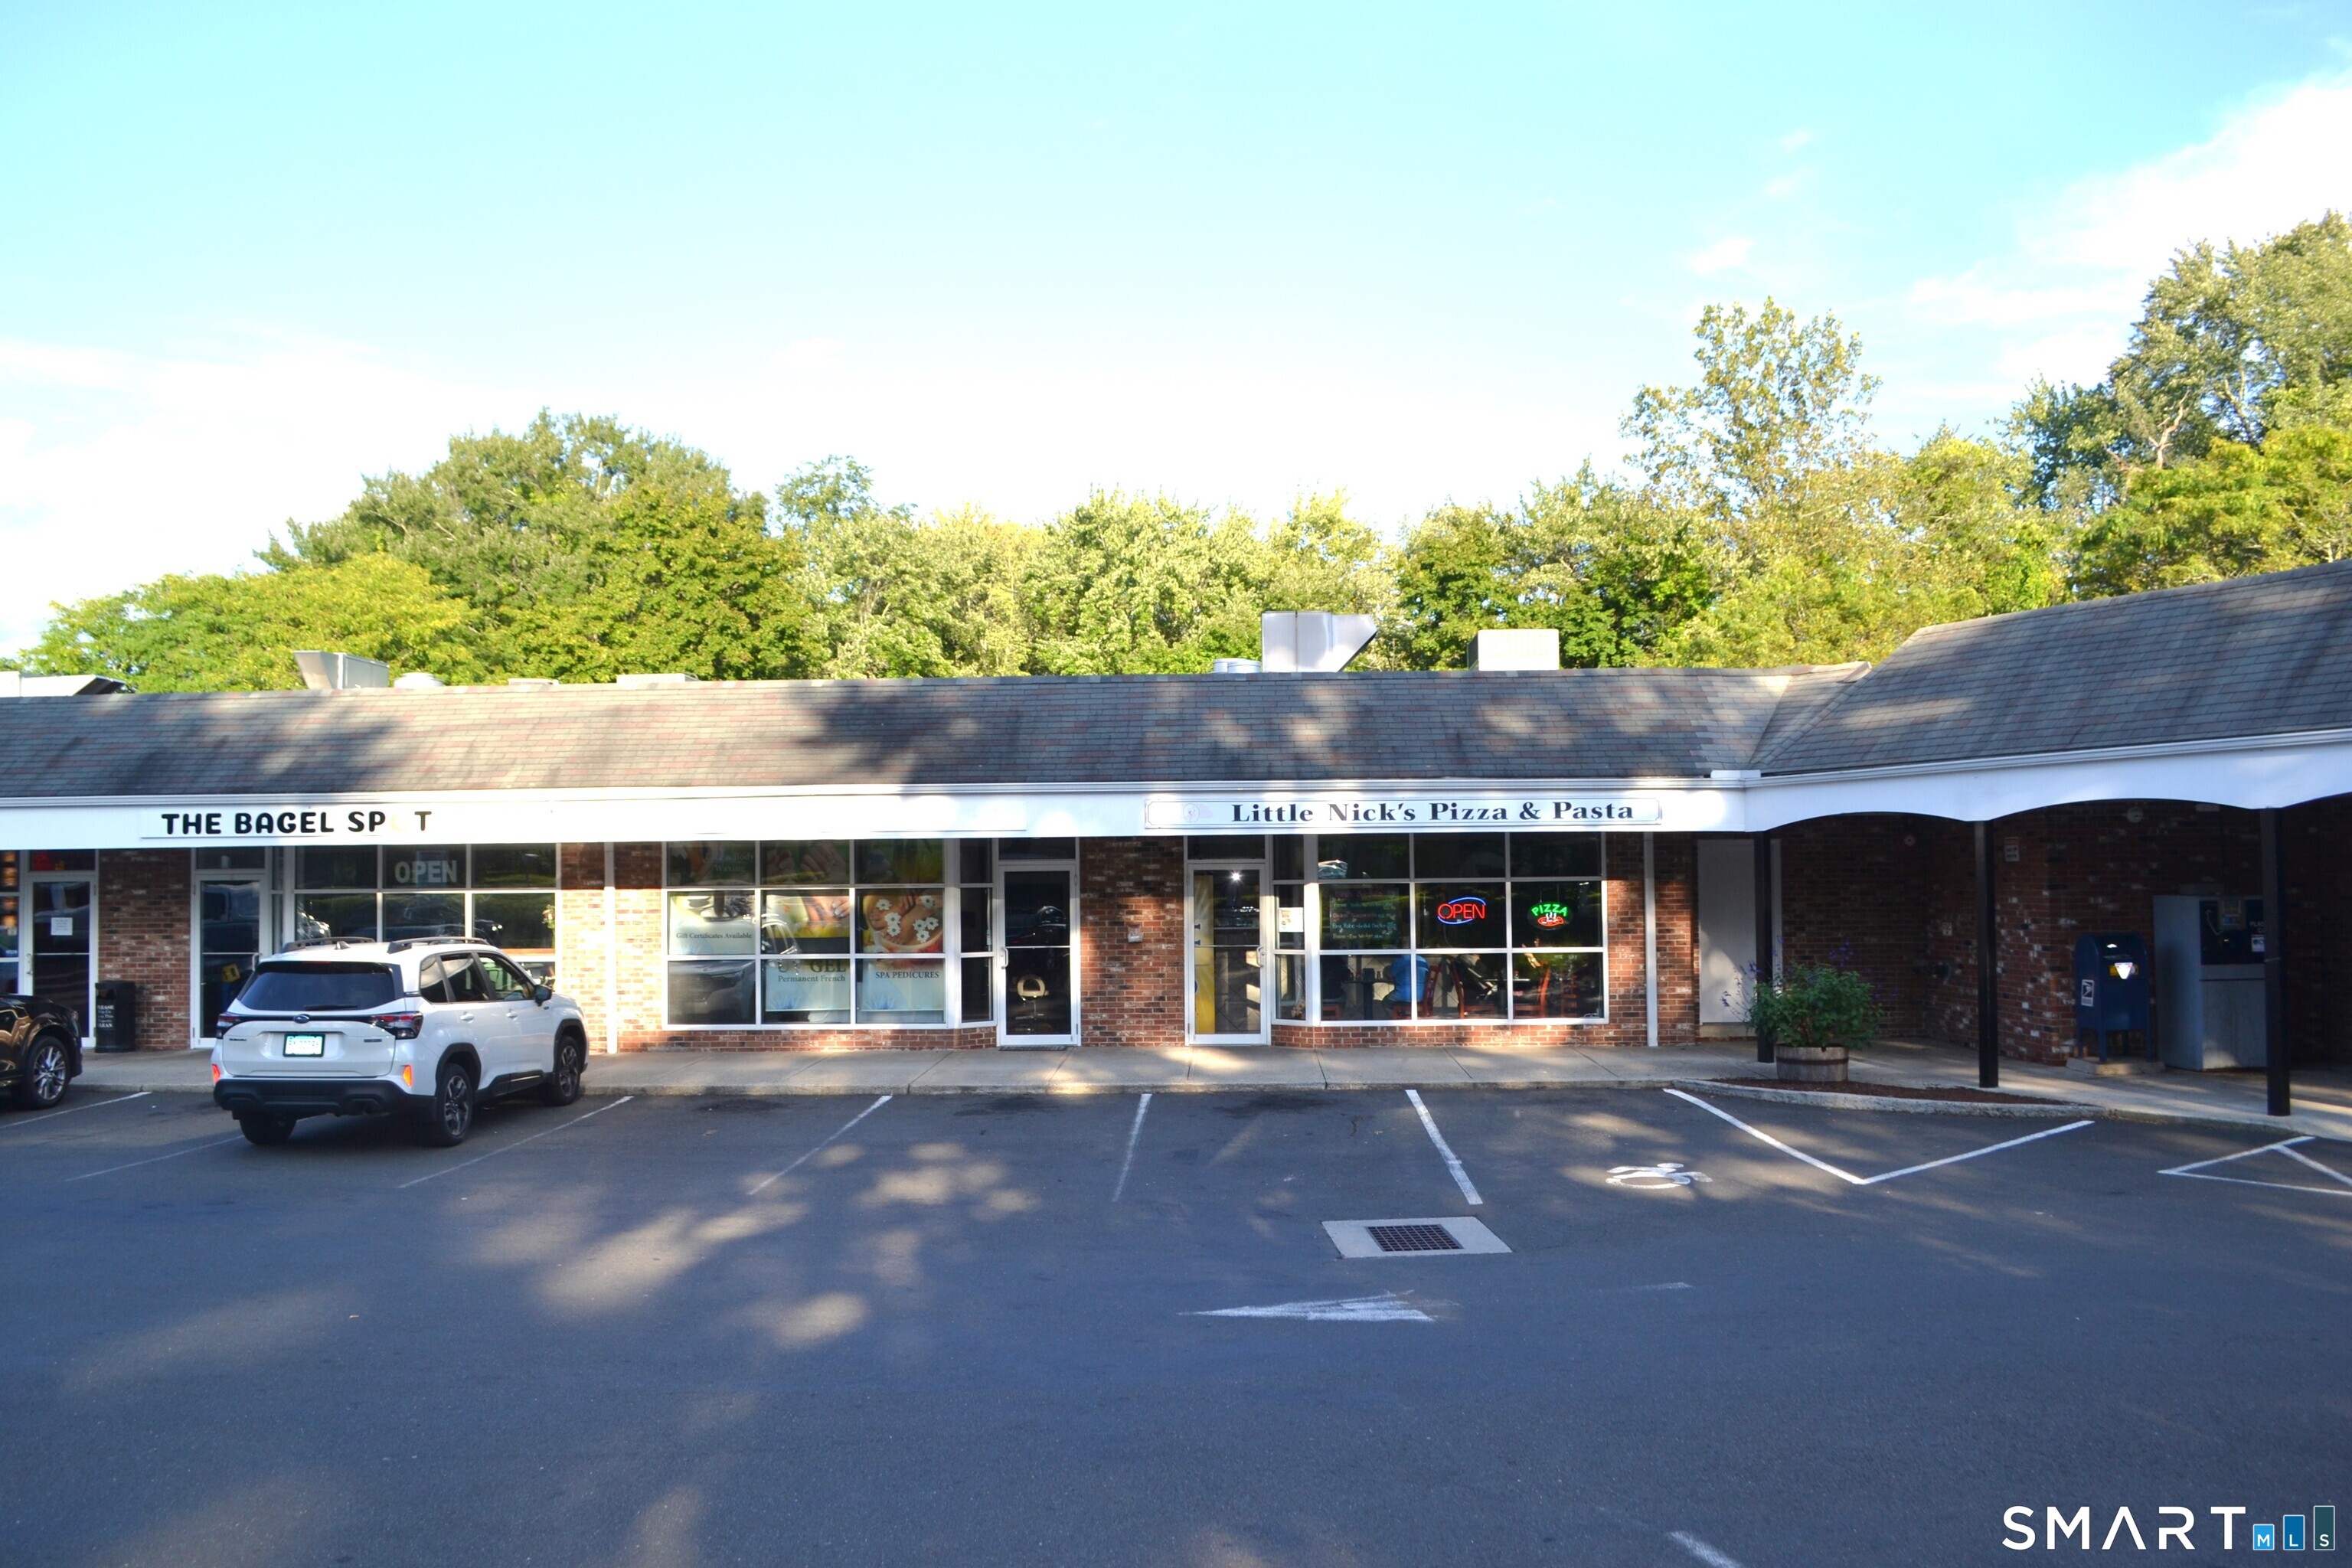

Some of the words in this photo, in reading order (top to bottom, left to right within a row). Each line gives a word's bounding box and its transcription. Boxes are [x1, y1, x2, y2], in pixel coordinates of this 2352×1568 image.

[1232, 804, 1313, 822] Little
[1328, 804, 1416, 822] Nick's
[1430, 802, 1508, 820] Pizza
[1519, 802, 1540, 820] &
[1553, 802, 1634, 819] Pasta
[162, 813, 222, 835] THE
[234, 812, 335, 835] BAGEL
[394, 860, 457, 884] OPEN
[1437, 903, 1486, 920] OPEN
[1531, 903, 1569, 917] PIZZA
[875, 971, 890, 979] SPA
[892, 971, 939, 979] PEDICURES
